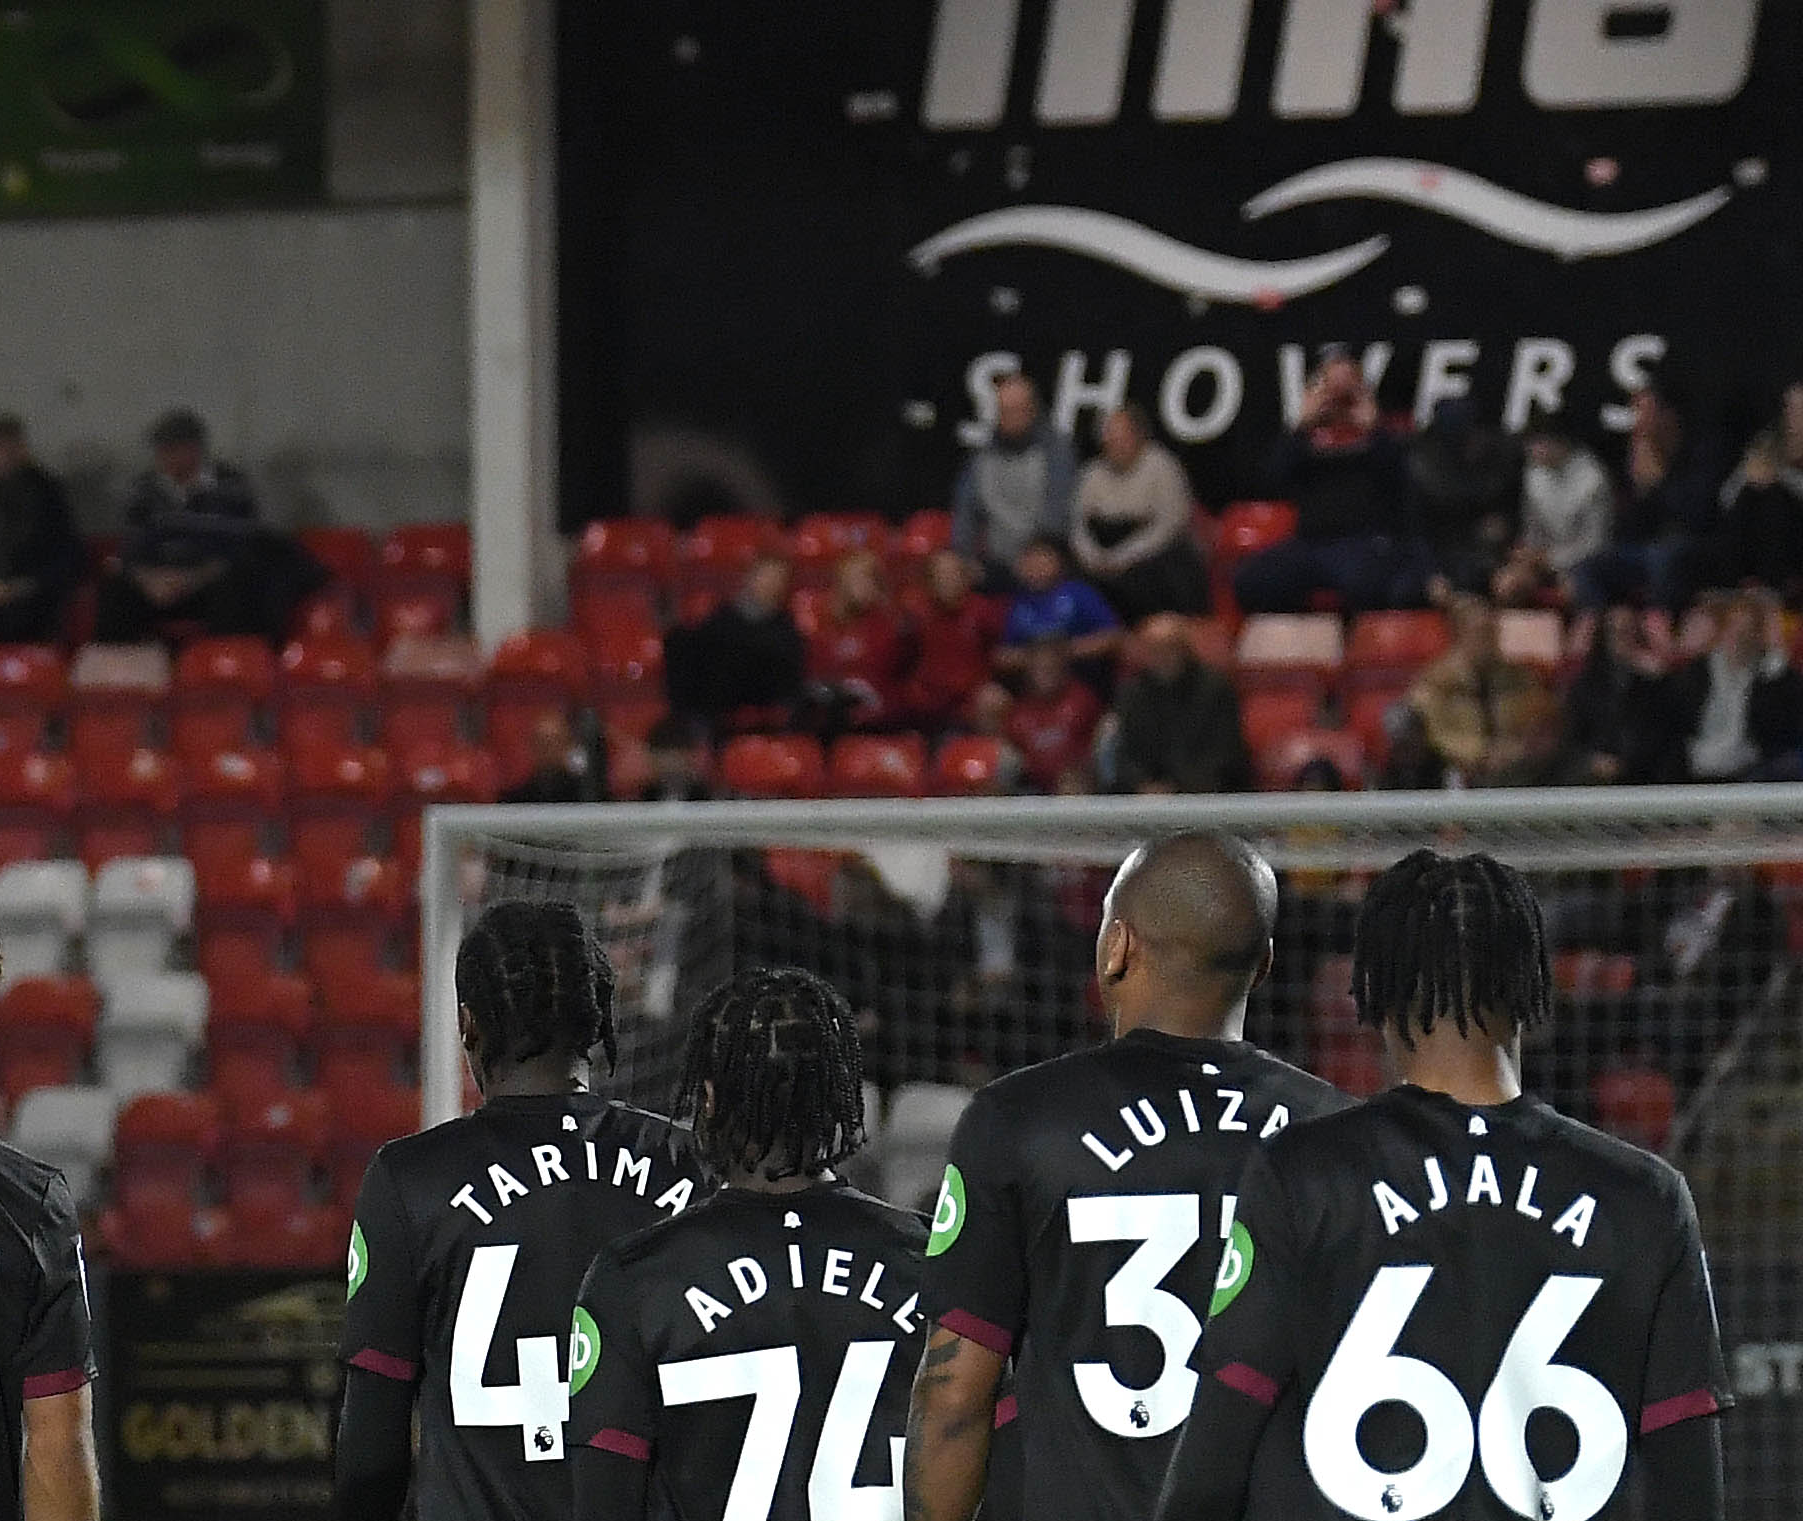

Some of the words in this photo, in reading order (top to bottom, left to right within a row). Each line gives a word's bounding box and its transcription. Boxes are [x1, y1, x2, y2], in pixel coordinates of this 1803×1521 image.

[449, 1139, 695, 1226] TARIMA
[1371, 1154, 1598, 1249] AJALA
[1066, 1193, 1238, 1439] 3
